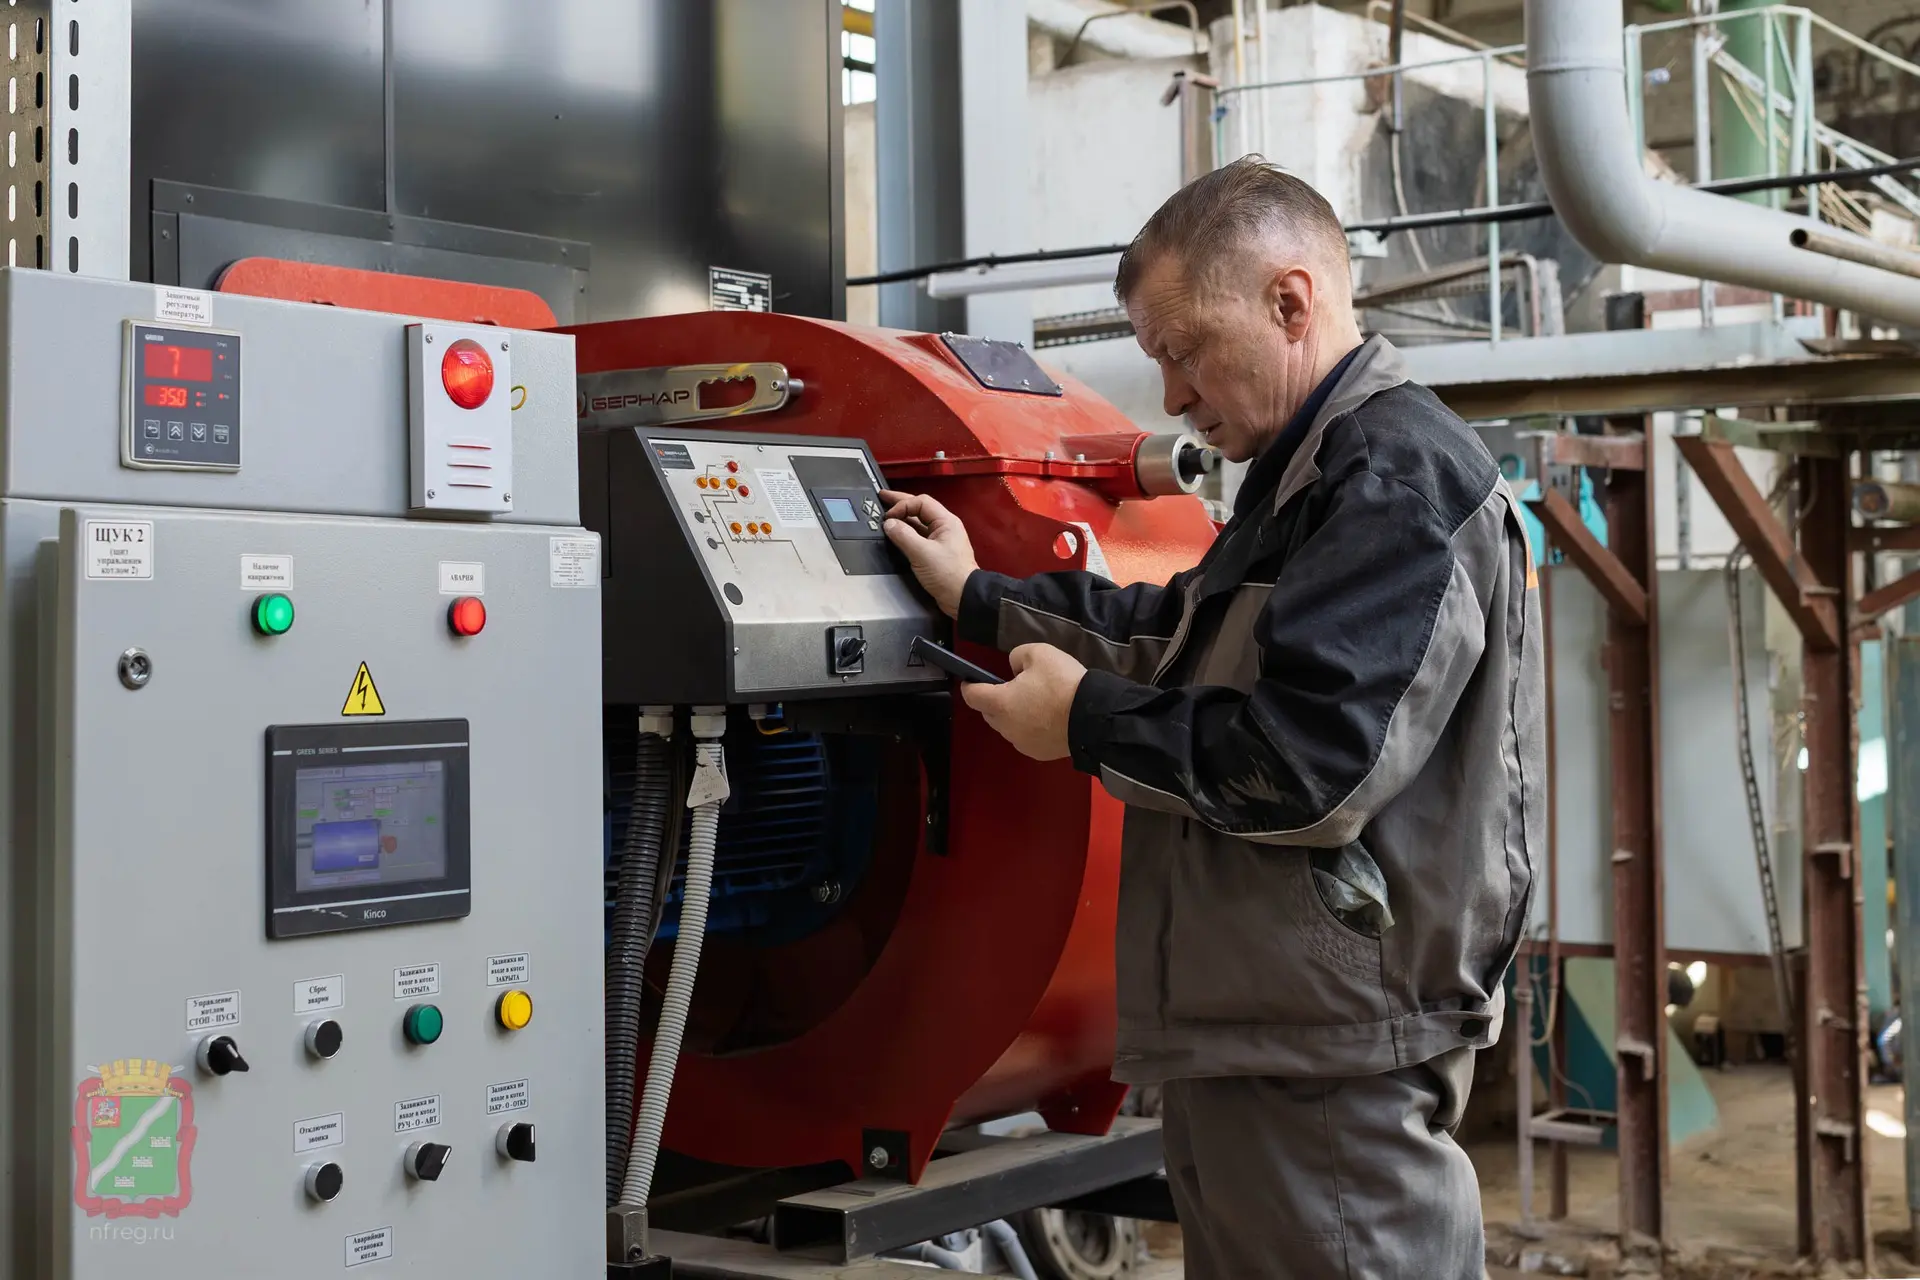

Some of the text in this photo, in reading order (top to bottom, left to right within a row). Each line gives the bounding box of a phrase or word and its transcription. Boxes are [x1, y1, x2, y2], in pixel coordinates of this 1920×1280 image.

[96, 528, 144, 544] ЩУК 2
[363, 909, 387, 920] Kinco
[496, 974, 520, 983] ЗАКРЫТА
[402, 985, 430, 995] ОТКРЫТА
[189, 1016, 210, 1026] СТОП
[216, 1012, 237, 1023] ПУСК
[299, 1122, 338, 1134] Отключение
[397, 1120, 411, 1129] РУЧ
[425, 1115, 438, 1124] АВТ
